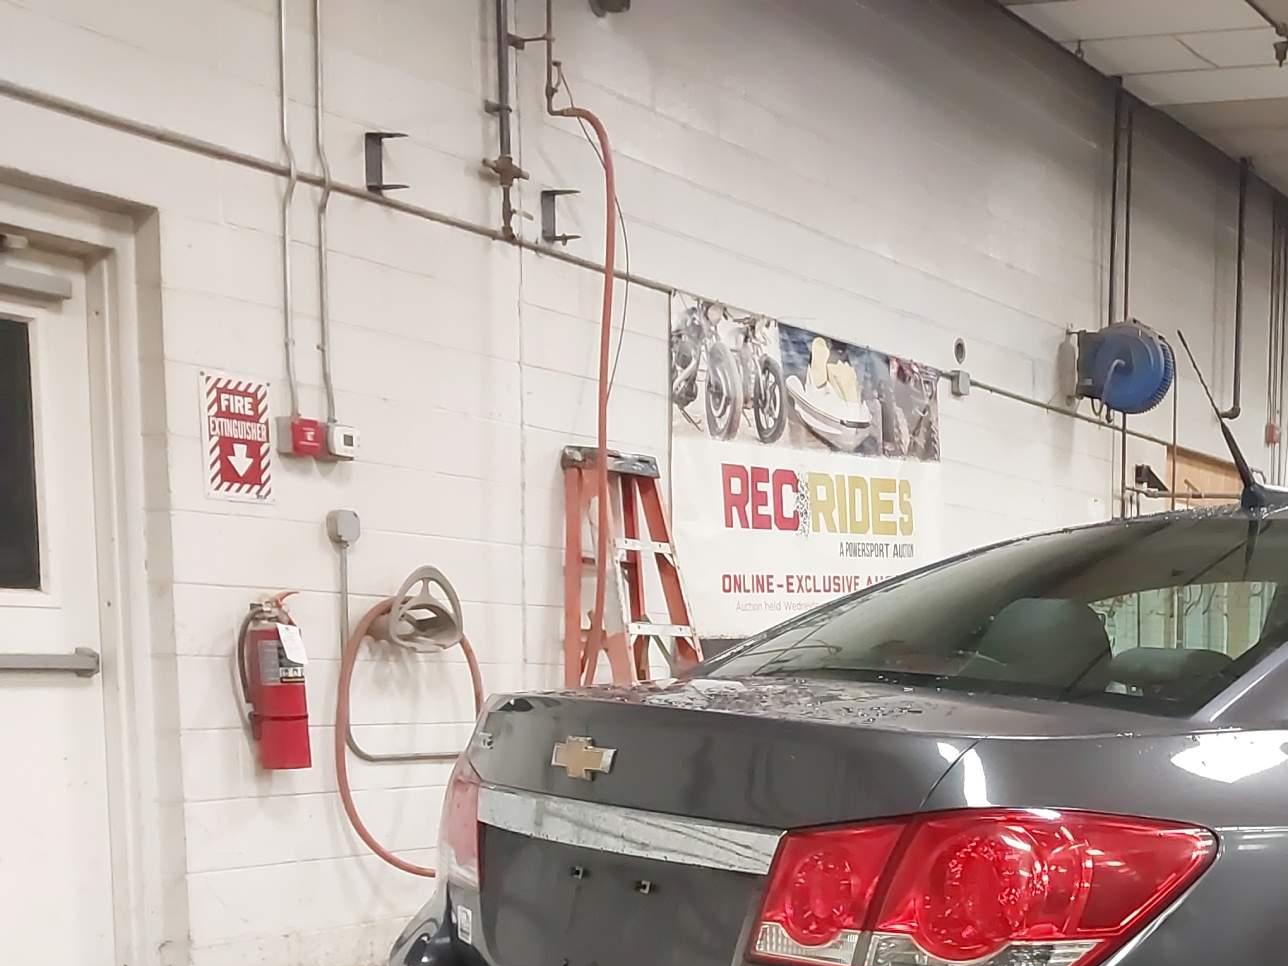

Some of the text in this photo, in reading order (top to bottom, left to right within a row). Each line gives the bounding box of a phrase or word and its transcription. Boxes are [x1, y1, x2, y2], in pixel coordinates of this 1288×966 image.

[220, 393, 254, 416] FIRE
[209, 417, 267, 442] EXTINGUISHER
[721, 463, 914, 537] REC RIDES
[840, 541, 914, 559] A POWERSPORT AUCTION
[721, 573, 861, 594] ONLINE-EXCLUSIVE
